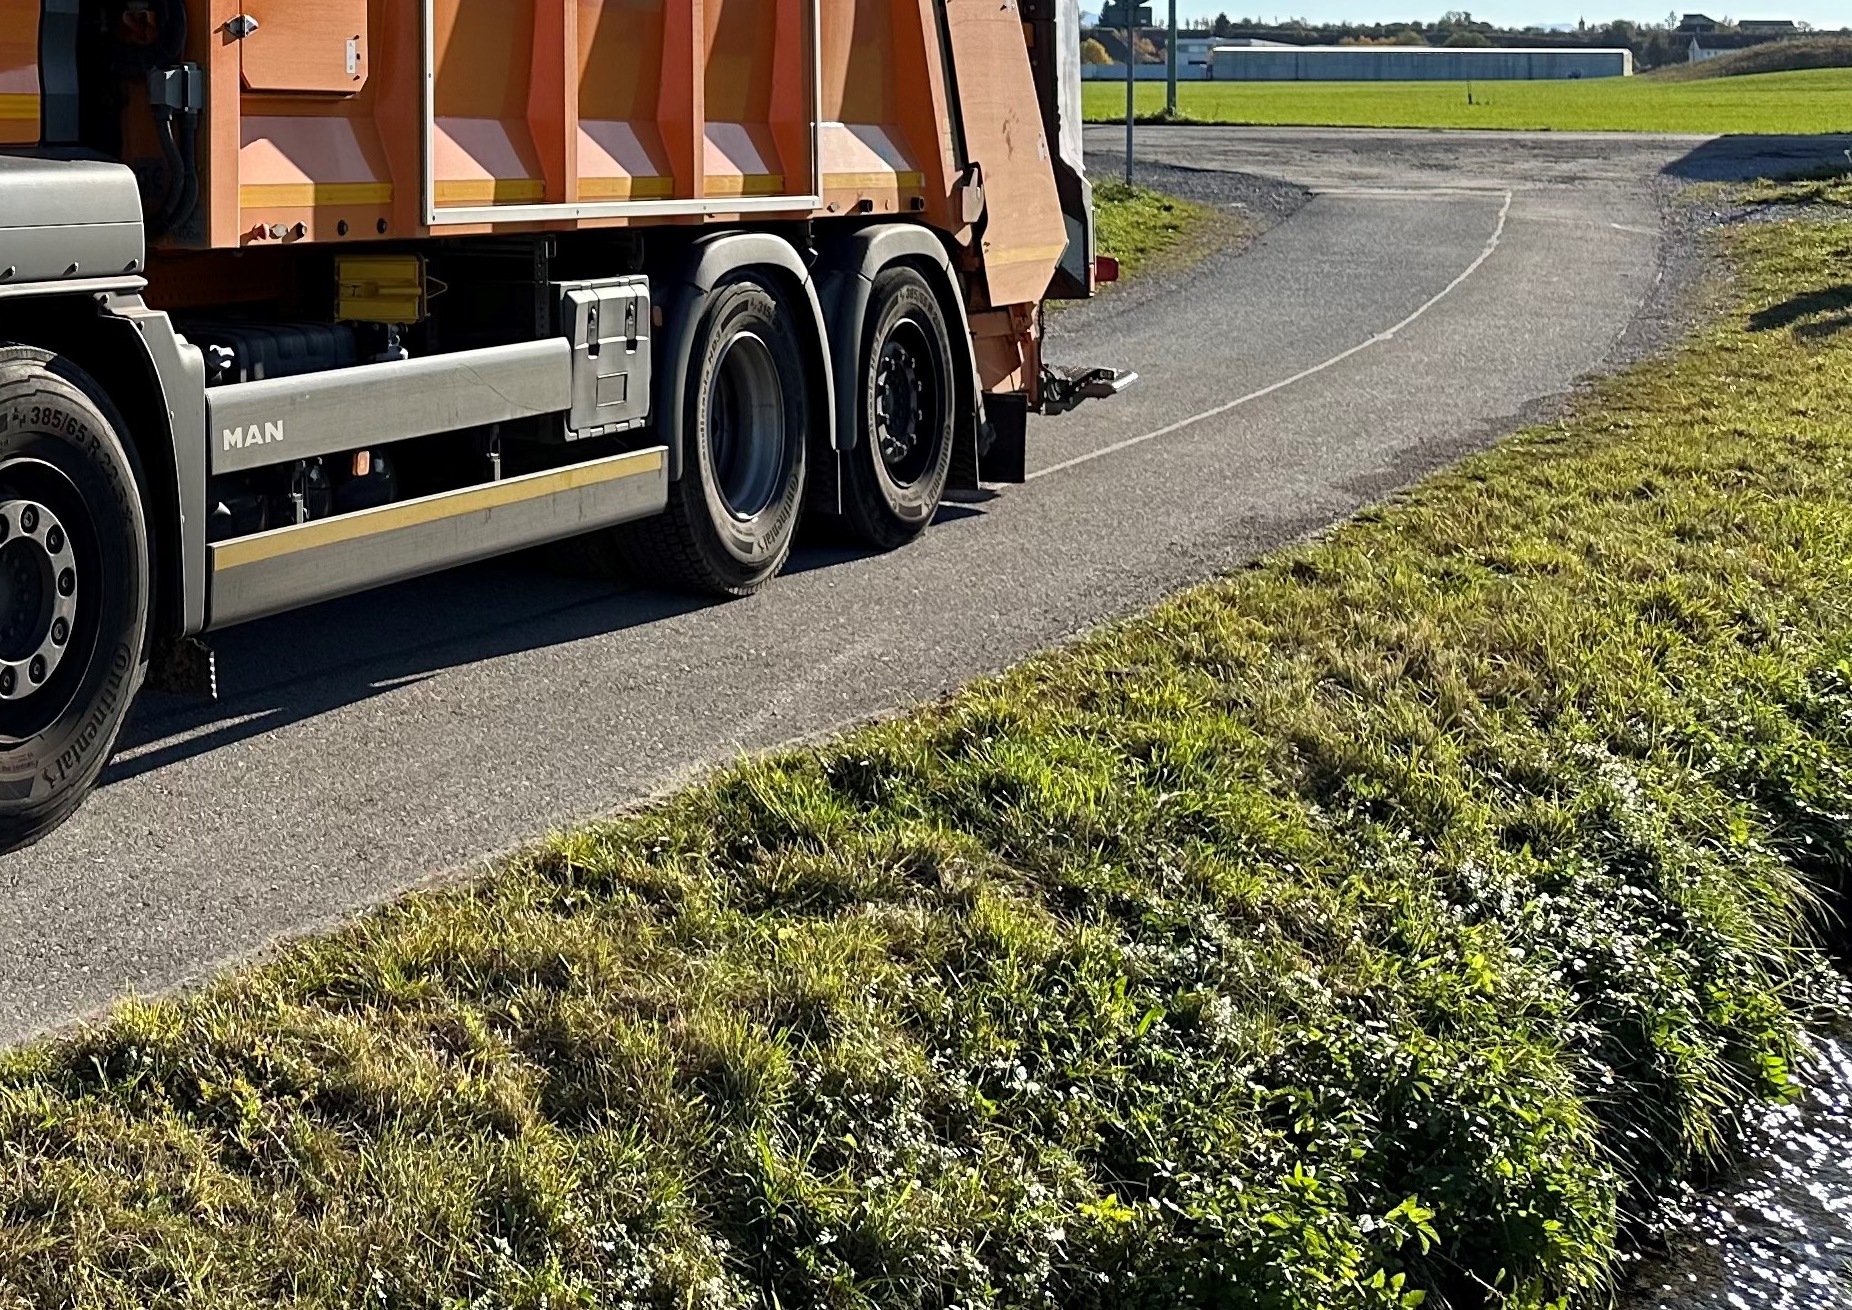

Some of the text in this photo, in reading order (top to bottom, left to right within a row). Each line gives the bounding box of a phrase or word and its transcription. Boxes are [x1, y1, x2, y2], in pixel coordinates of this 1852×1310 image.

[30, 405, 89, 441] 385/65
[222, 419, 284, 451] MAN
[53, 642, 132, 779] Continental
